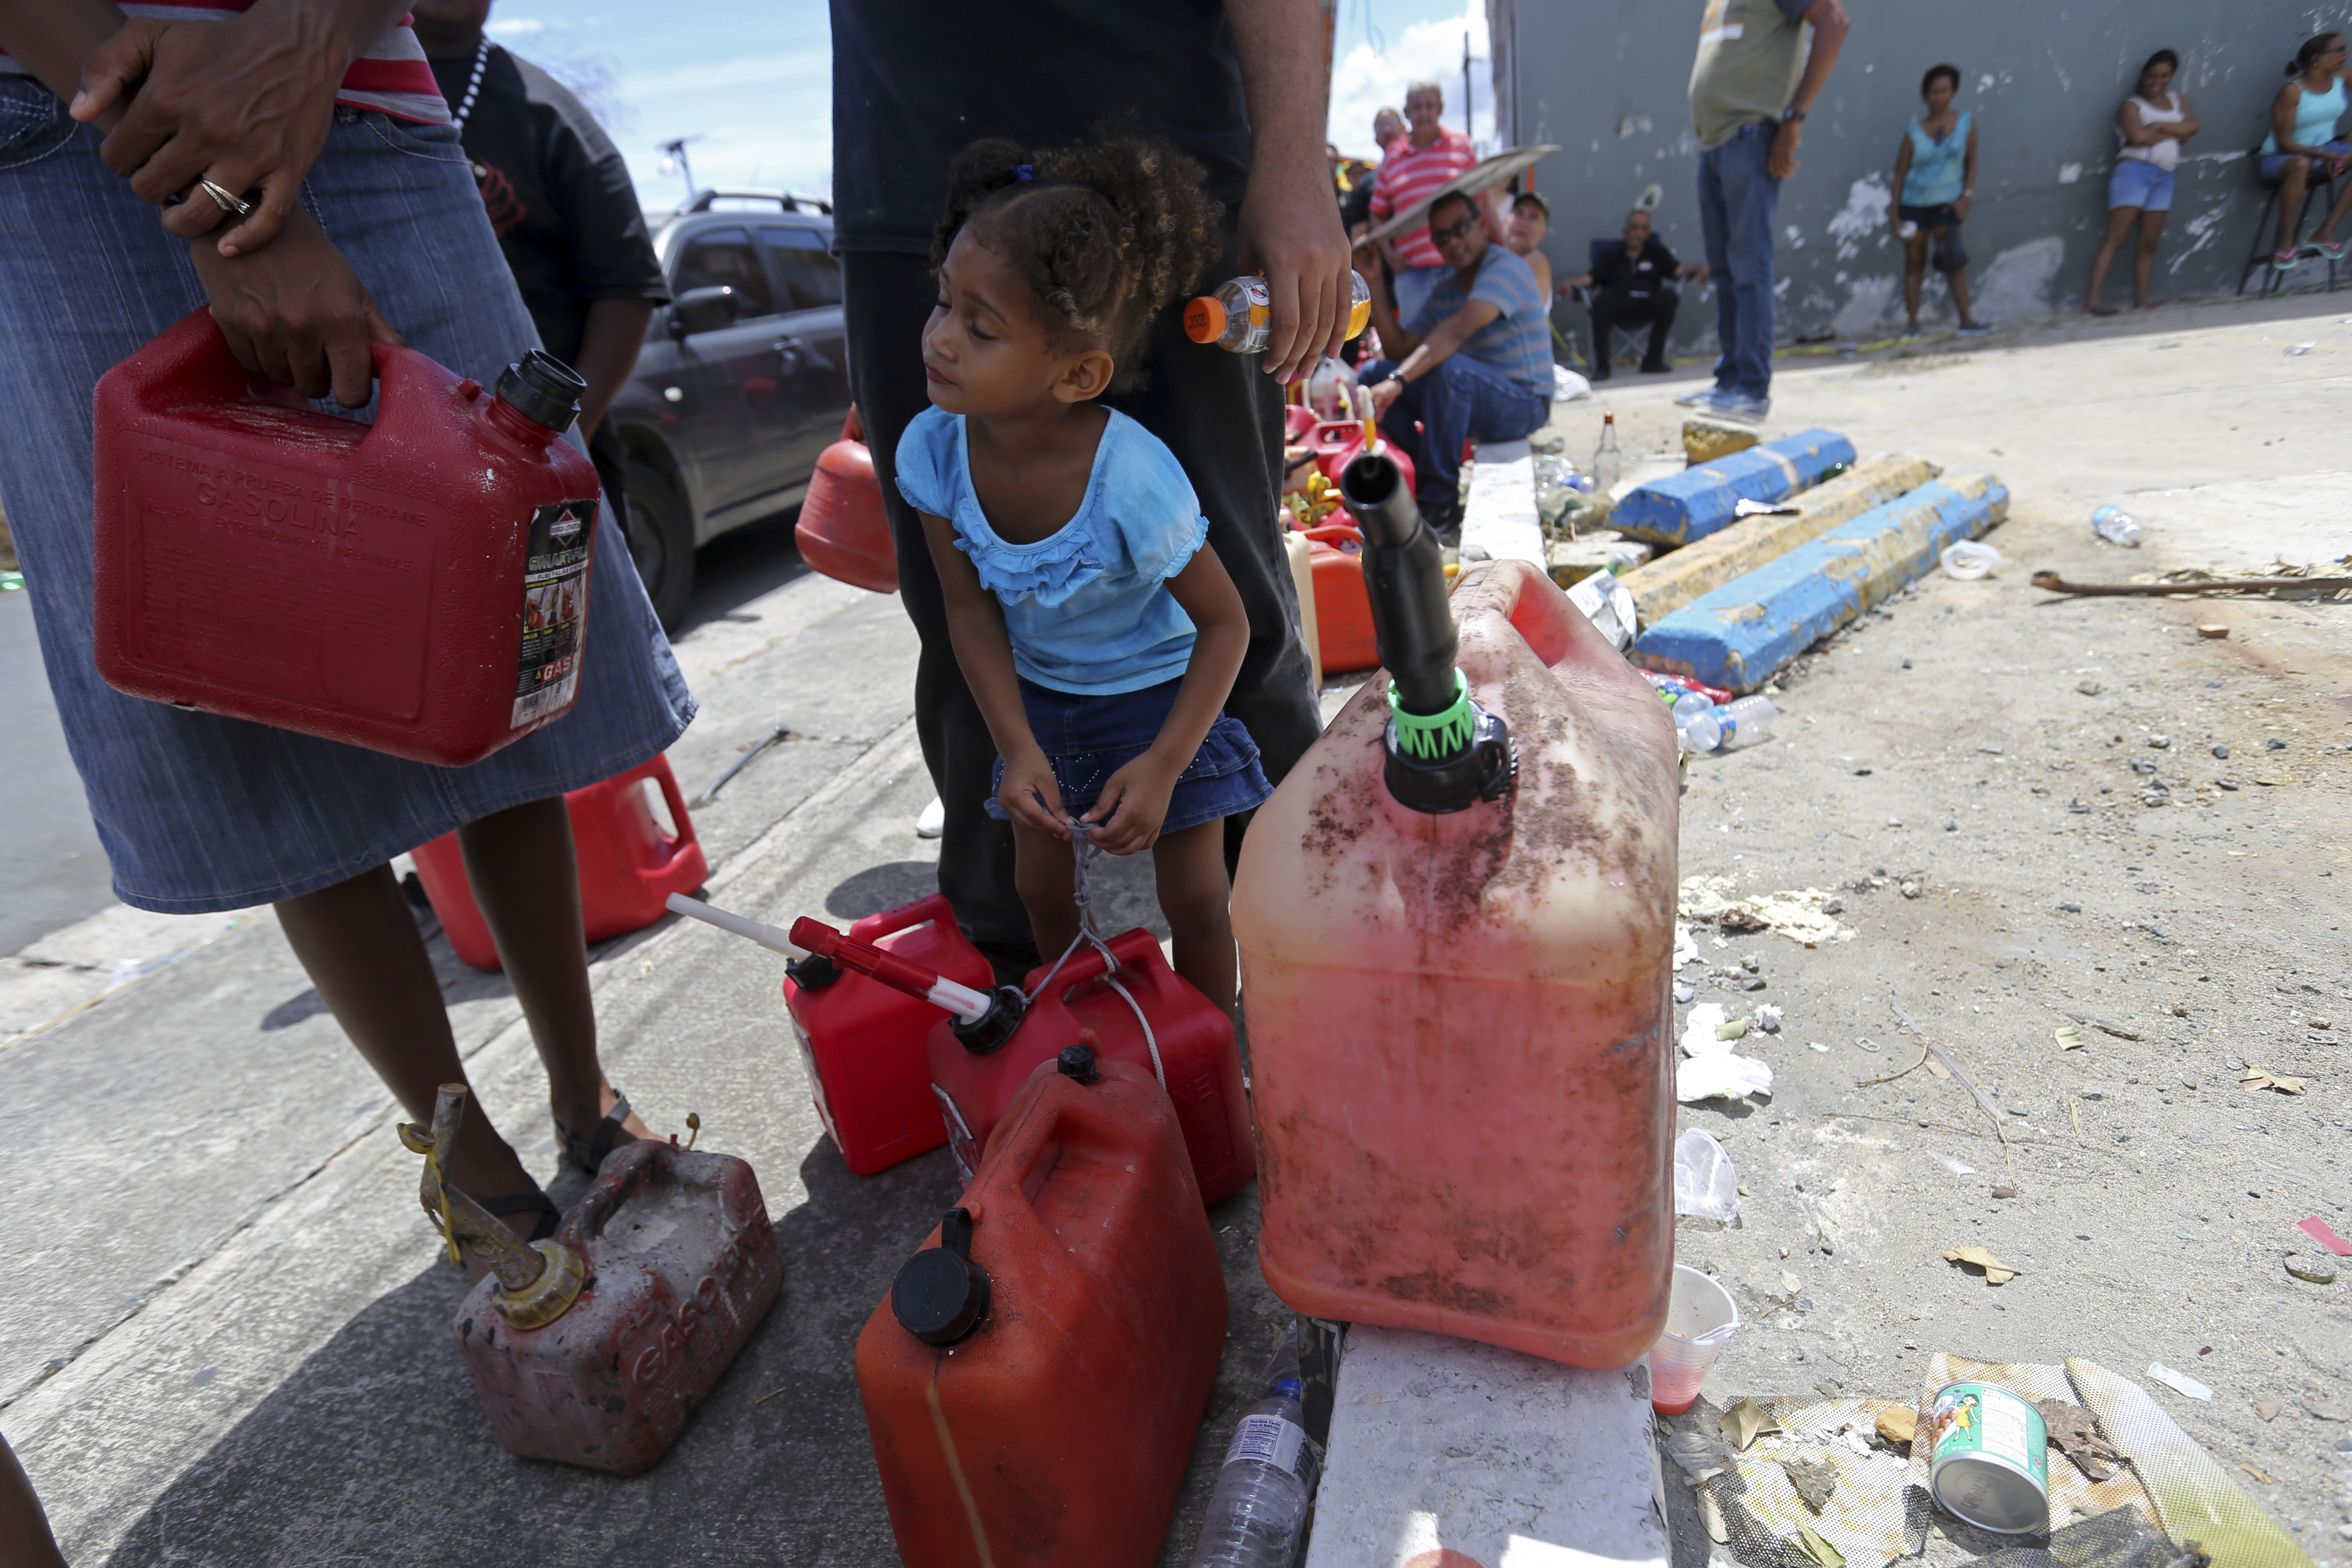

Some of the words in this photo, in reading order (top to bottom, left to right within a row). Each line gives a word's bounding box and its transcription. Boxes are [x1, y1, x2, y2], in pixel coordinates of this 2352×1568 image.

[137, 447, 212, 477] SISTEMA
[217, 467, 229, 481] A
[235, 470, 305, 500] PRUEBA
[311, 488, 334, 506] DE
[339, 495, 427, 527] DERRAME
[195, 479, 365, 542] GASOLINA
[216, 516, 328, 553] EXTREMADAMENTE
[552, 568, 569, 577] FILLING
[569, 563, 583, 573] SYSTEM
[543, 656, 573, 681] GAS
[1983, 1388, 2012, 1401] Nutrition
[1983, 1392, 2001, 1400] Facts
